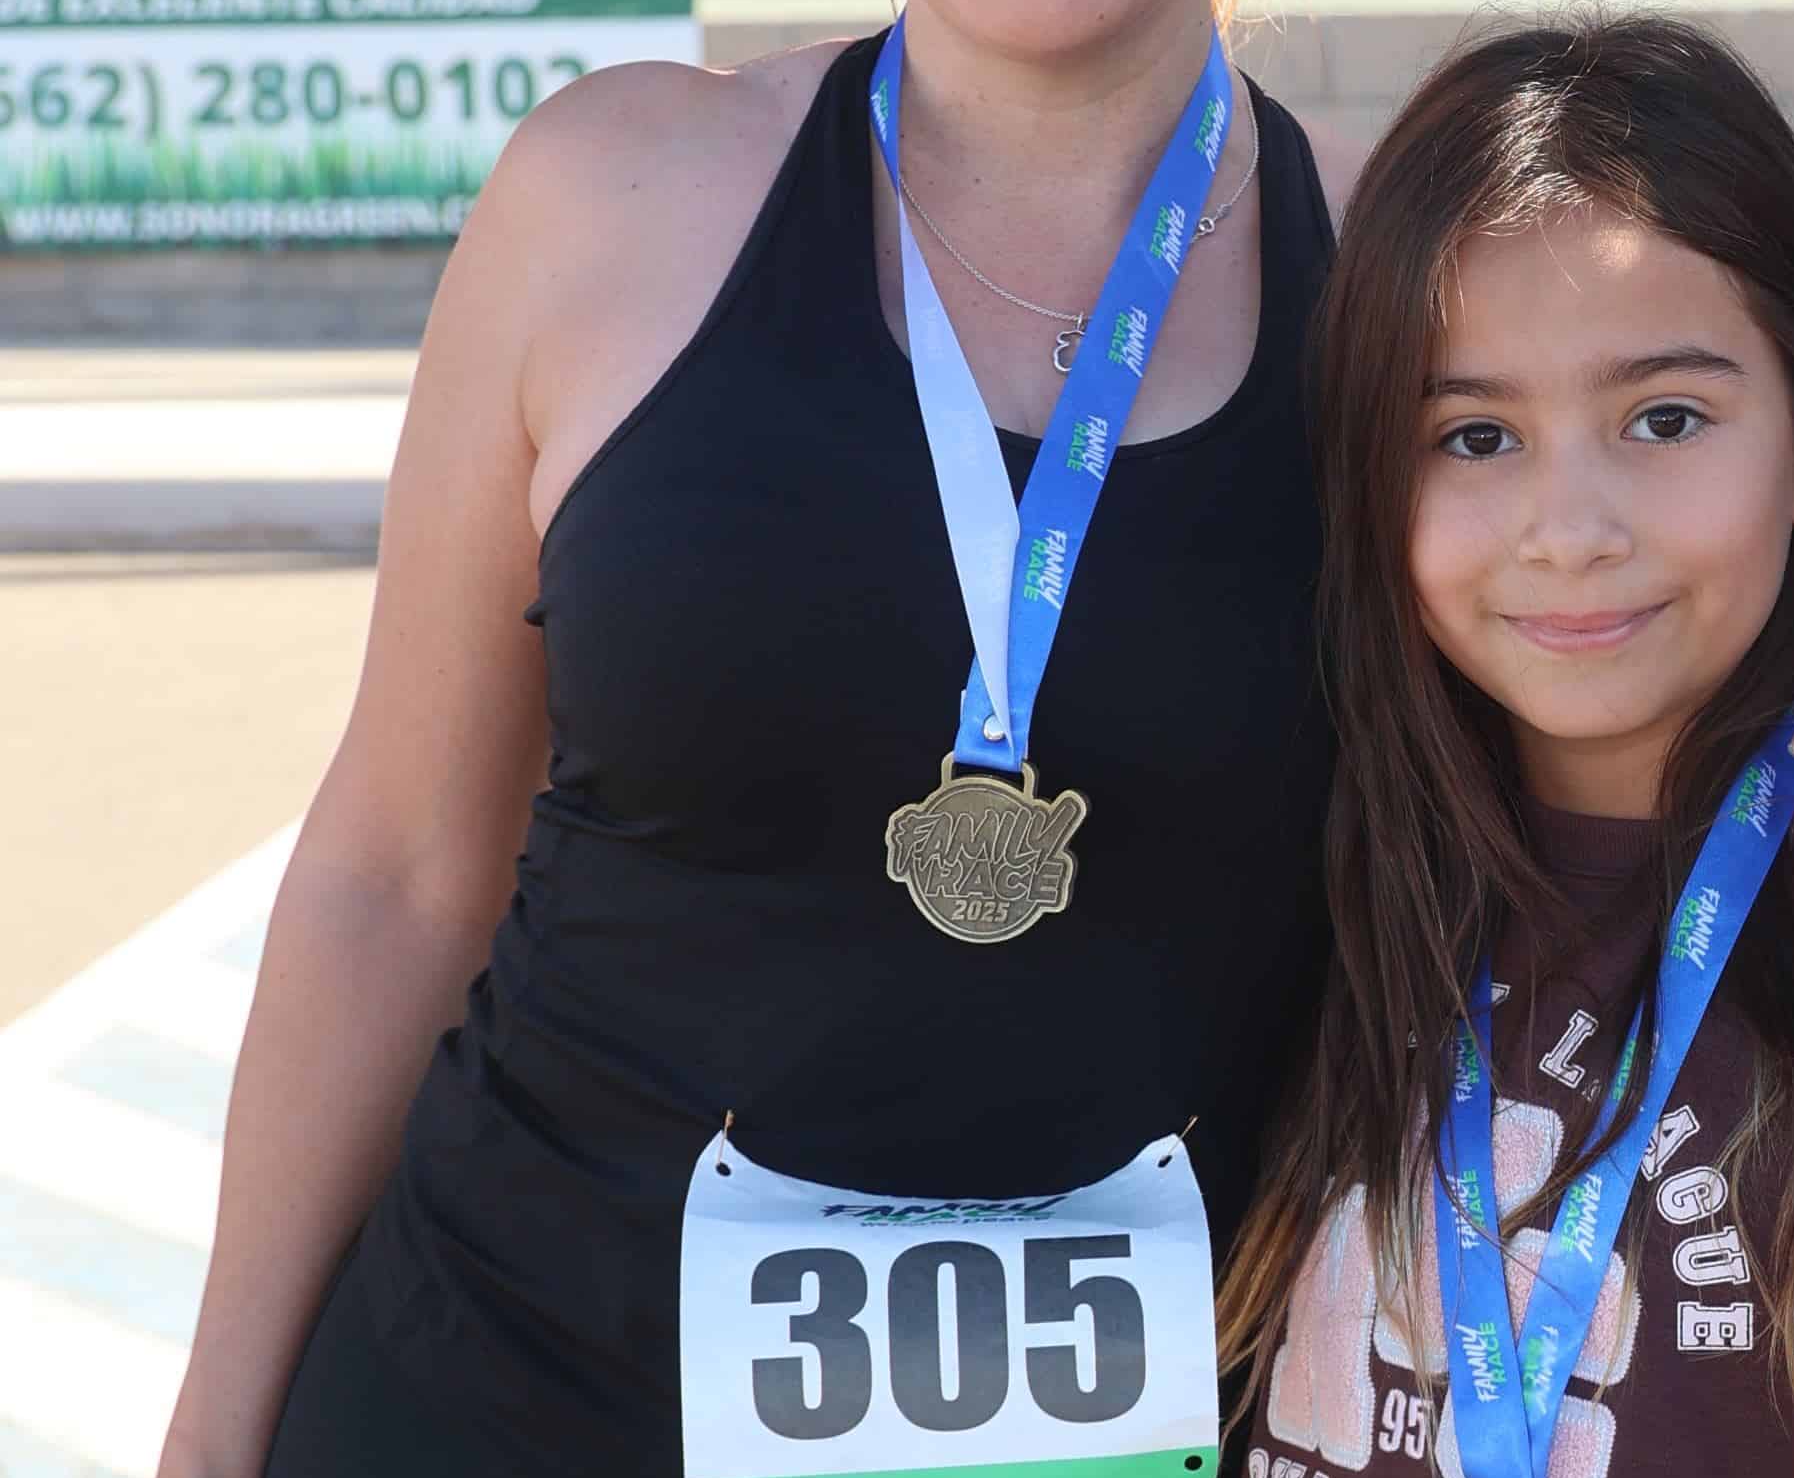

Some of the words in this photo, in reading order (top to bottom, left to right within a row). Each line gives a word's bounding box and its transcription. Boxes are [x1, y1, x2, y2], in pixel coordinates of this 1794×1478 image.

[1205, 96, 1226, 172] FAMILY
[1150, 205, 1170, 259] RACE
[1161, 201, 1186, 275] FAMILY
[1107, 312, 1129, 364] RACE
[1123, 307, 1149, 379] FAMILY
[1067, 422, 1089, 473] RACE
[1085, 414, 1109, 481] FAMILY
[1024, 538, 1047, 602] RACE
[1040, 528, 1067, 611] FAMILY
[1729, 764, 1761, 826] RACE
[1748, 760, 1777, 838] FAMILY
[895, 803, 1077, 874] FAMILY
[926, 858, 1064, 903] RACE
[951, 900, 1010, 922] 2025
[1671, 897, 1699, 961] RACE
[1687, 885, 1721, 970] FAMILY
[1538, 1009, 1754, 1351] LAGUE
[1560, 1185, 1586, 1252] RACE
[1575, 1173, 1603, 1263] FAMILY
[750, 1233, 1146, 1440] 305
[1455, 1323, 1500, 1404] FAMILY
[1480, 1322, 1506, 1384] RACE
[1379, 1388, 1427, 1460] 95
